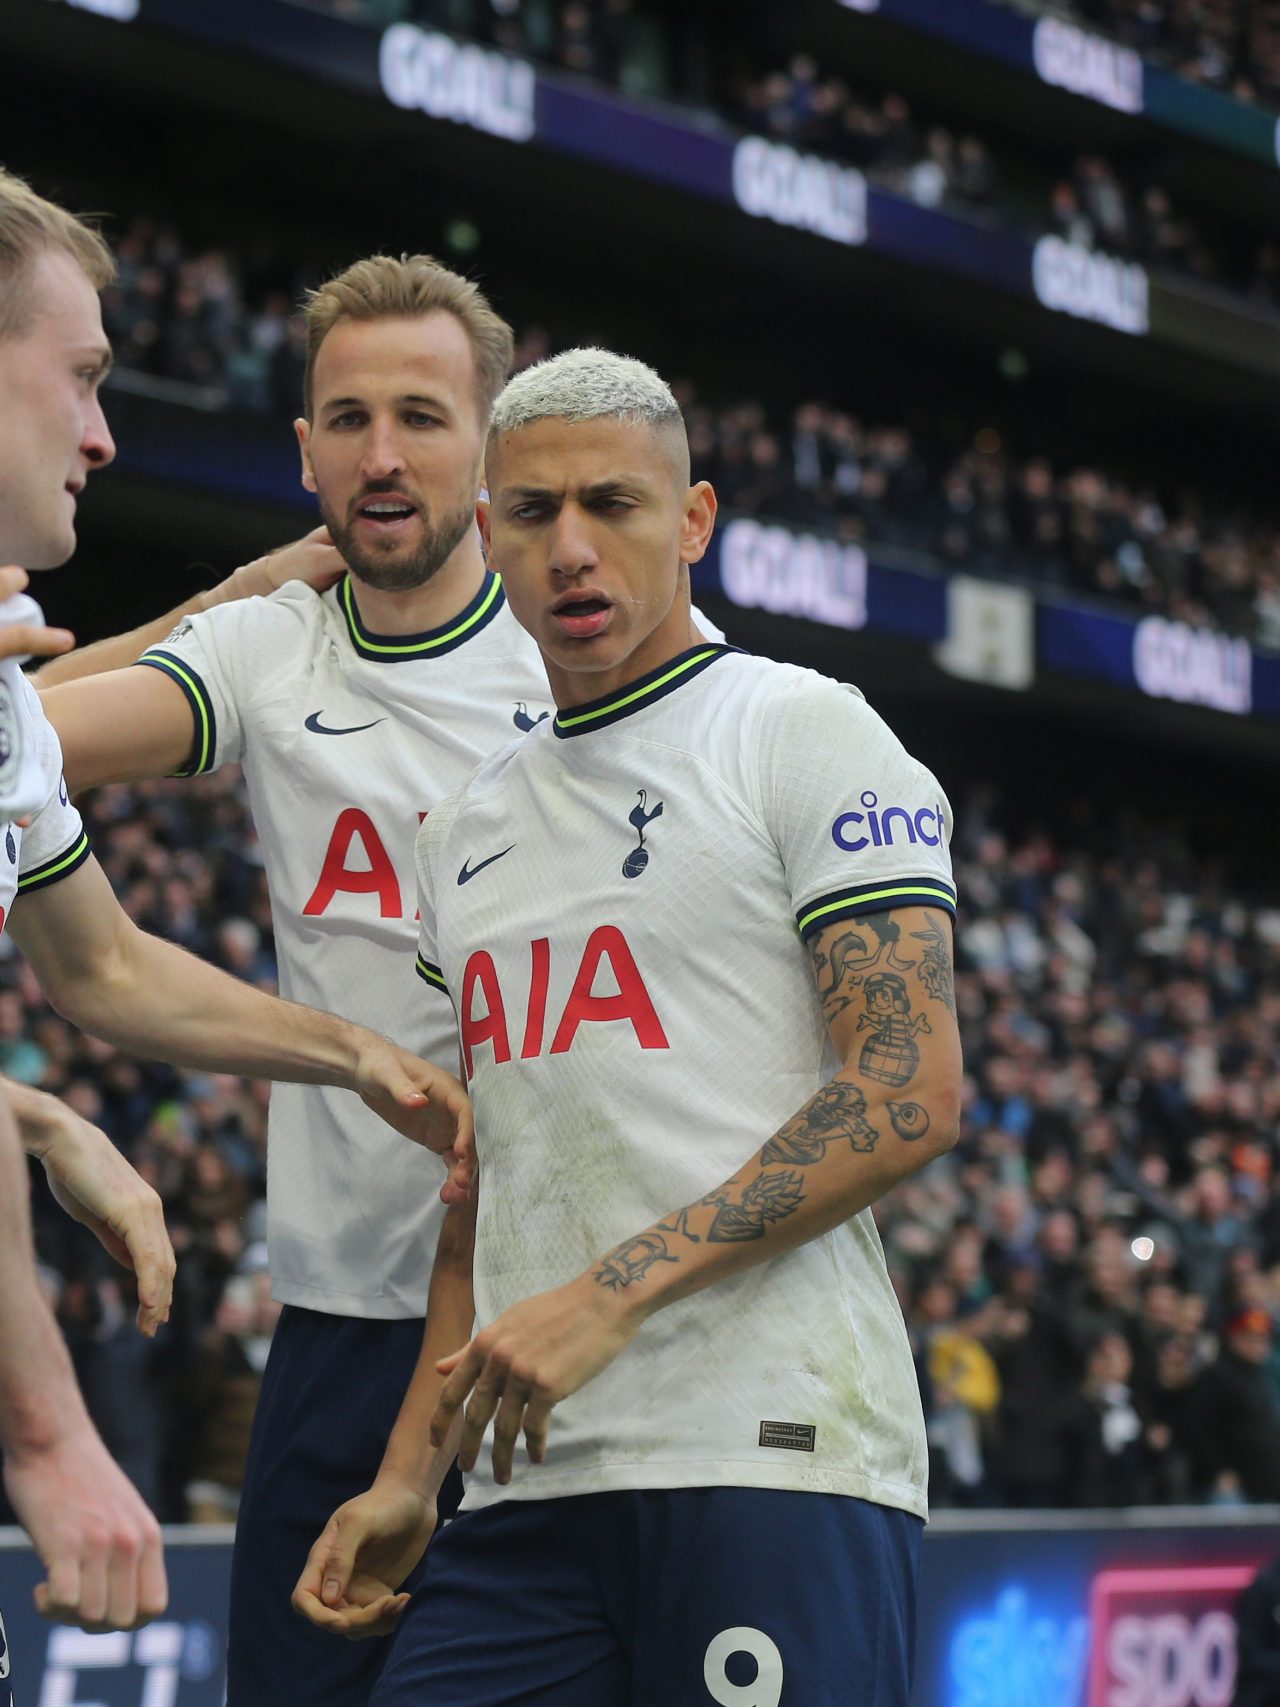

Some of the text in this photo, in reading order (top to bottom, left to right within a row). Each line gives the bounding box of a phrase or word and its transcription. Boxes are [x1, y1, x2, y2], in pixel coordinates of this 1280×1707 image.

[302, 807, 428, 920] A
[461, 925, 670, 1082] AIA
[704, 1626, 784, 1707] 9
